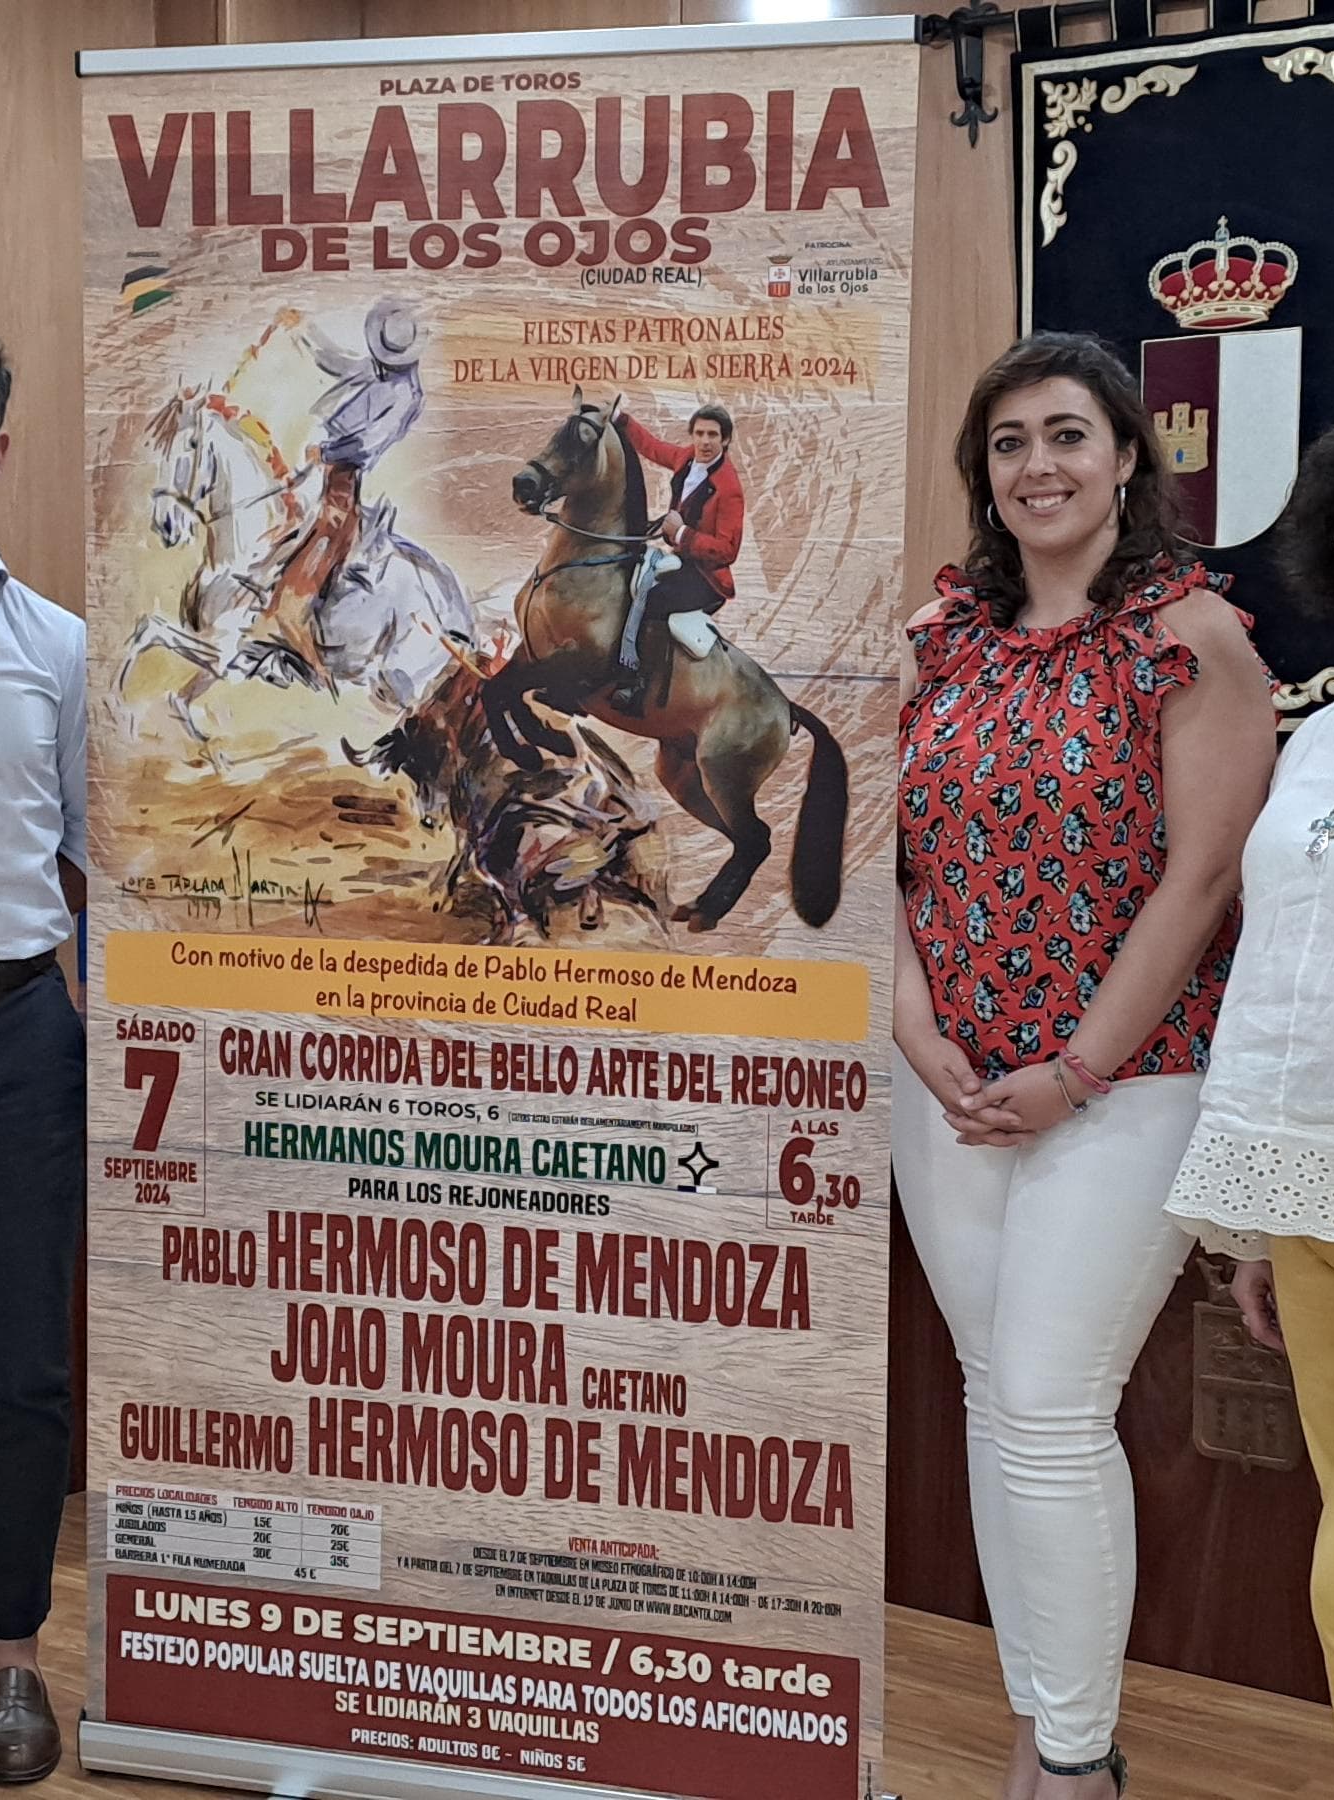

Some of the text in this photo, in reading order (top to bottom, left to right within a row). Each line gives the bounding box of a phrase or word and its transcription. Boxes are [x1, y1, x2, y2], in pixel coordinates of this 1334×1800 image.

[380, 71, 582, 96] PLAZA DE TOROS
[107, 86, 890, 228] VILLARRUBIA
[262, 216, 712, 273] DE LOS OJOS
[579, 265, 703, 290] (CIUDAD REAL)
[798, 267, 878, 282] Villarrubia
[798, 282, 869, 296] de los Ojos
[523, 315, 785, 345] FIESTAS PATRONALES
[454, 352, 857, 384] DE LA VIRGEN DE LA SIERRA 2024
[171, 941, 798, 994] Con motivo de la despedida de Pablo Hermoso de Mendoza
[316, 984, 637, 1022] en la provincia de Ciudad Real
[116, 1013, 196, 1043] SÁBADO
[219, 1027, 866, 1112] GRAN CORRIDA DEL BELLO ARTE DEL REJONEO
[124, 1047, 180, 1152] 7
[255, 1091, 500, 1122] SE LIDIARÁN 6 TOROS, 6
[790, 1120, 839, 1136] A LAS
[244, 1121, 666, 1185] HERMANOS MOURA CAETANO
[104, 1157, 198, 1183] SEPTIEMBRE
[779, 1137, 861, 1212] 6,30
[135, 1182, 171, 1205] 2024
[349, 1178, 610, 1216] PARA LOS REJONEADORES
[790, 1211, 835, 1225] TARDE
[162, 1209, 812, 1331] PABLO HERMOSO DE MENDOZA
[271, 1304, 687, 1418] JOAO MOURA CAETANO
[120, 1396, 854, 1530] GUILLERMO HERMOSO DE MENDOZA
[148, 1502, 182, 1519] (HASTA
[185, 1510, 196, 1520] 15
[254, 1517, 272, 1528] 15€
[275, 1501, 299, 1513] ALTO
[253, 1532, 272, 1544] 20€
[331, 1524, 349, 1536] 20€
[253, 1547, 272, 1559] 30€
[331, 1540, 349, 1552] 25€
[569, 1537, 597, 1554] VENTA
[173, 1554, 191, 1567] FILA
[294, 1568, 306, 1579] 45
[330, 1556, 349, 1568] 35€
[602, 1578, 627, 1593] PLAZA
[134, 1588, 832, 1698] LUNES 9 DE SEPTIEMBRE / 6,30 tarde
[120, 1630, 849, 1747] FESTEJO POPULAR SUELTA DE VAQUILLAS PARA TODOS LOS AFICIONADOS
[335, 1691, 600, 1745] SE LIDIARÁN 3 VAQUILLAS
[351, 1727, 414, 1750] PRECIOS:
[417, 1736, 478, 1758] ADULTOS
[519, 1747, 563, 1769] NIÑOS
[567, 1756, 586, 1772] 5€
